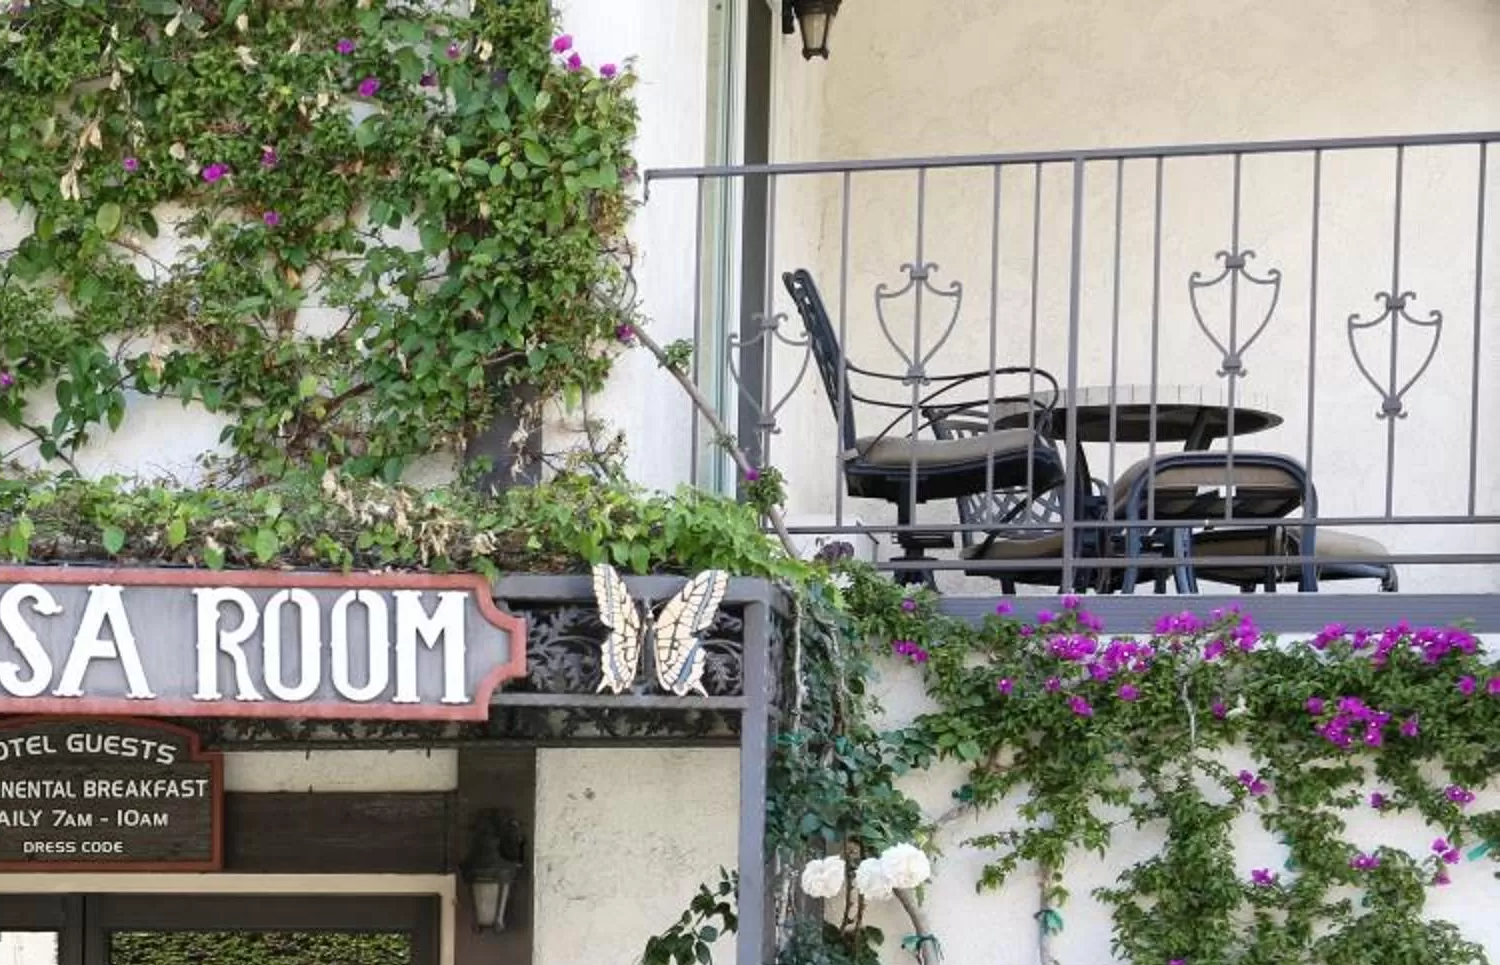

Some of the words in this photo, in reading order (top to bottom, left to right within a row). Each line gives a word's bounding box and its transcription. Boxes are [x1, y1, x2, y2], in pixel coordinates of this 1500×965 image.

[192, 586, 469, 703] ROOM
[66, 733, 177, 765] GUESTS
[83, 779, 209, 798] BREAKFAST
[51, 809, 93, 828] 7AM
[117, 809, 169, 828] 10AM
[23, 841, 77, 853] DRESS
[81, 841, 123, 853] CODE
